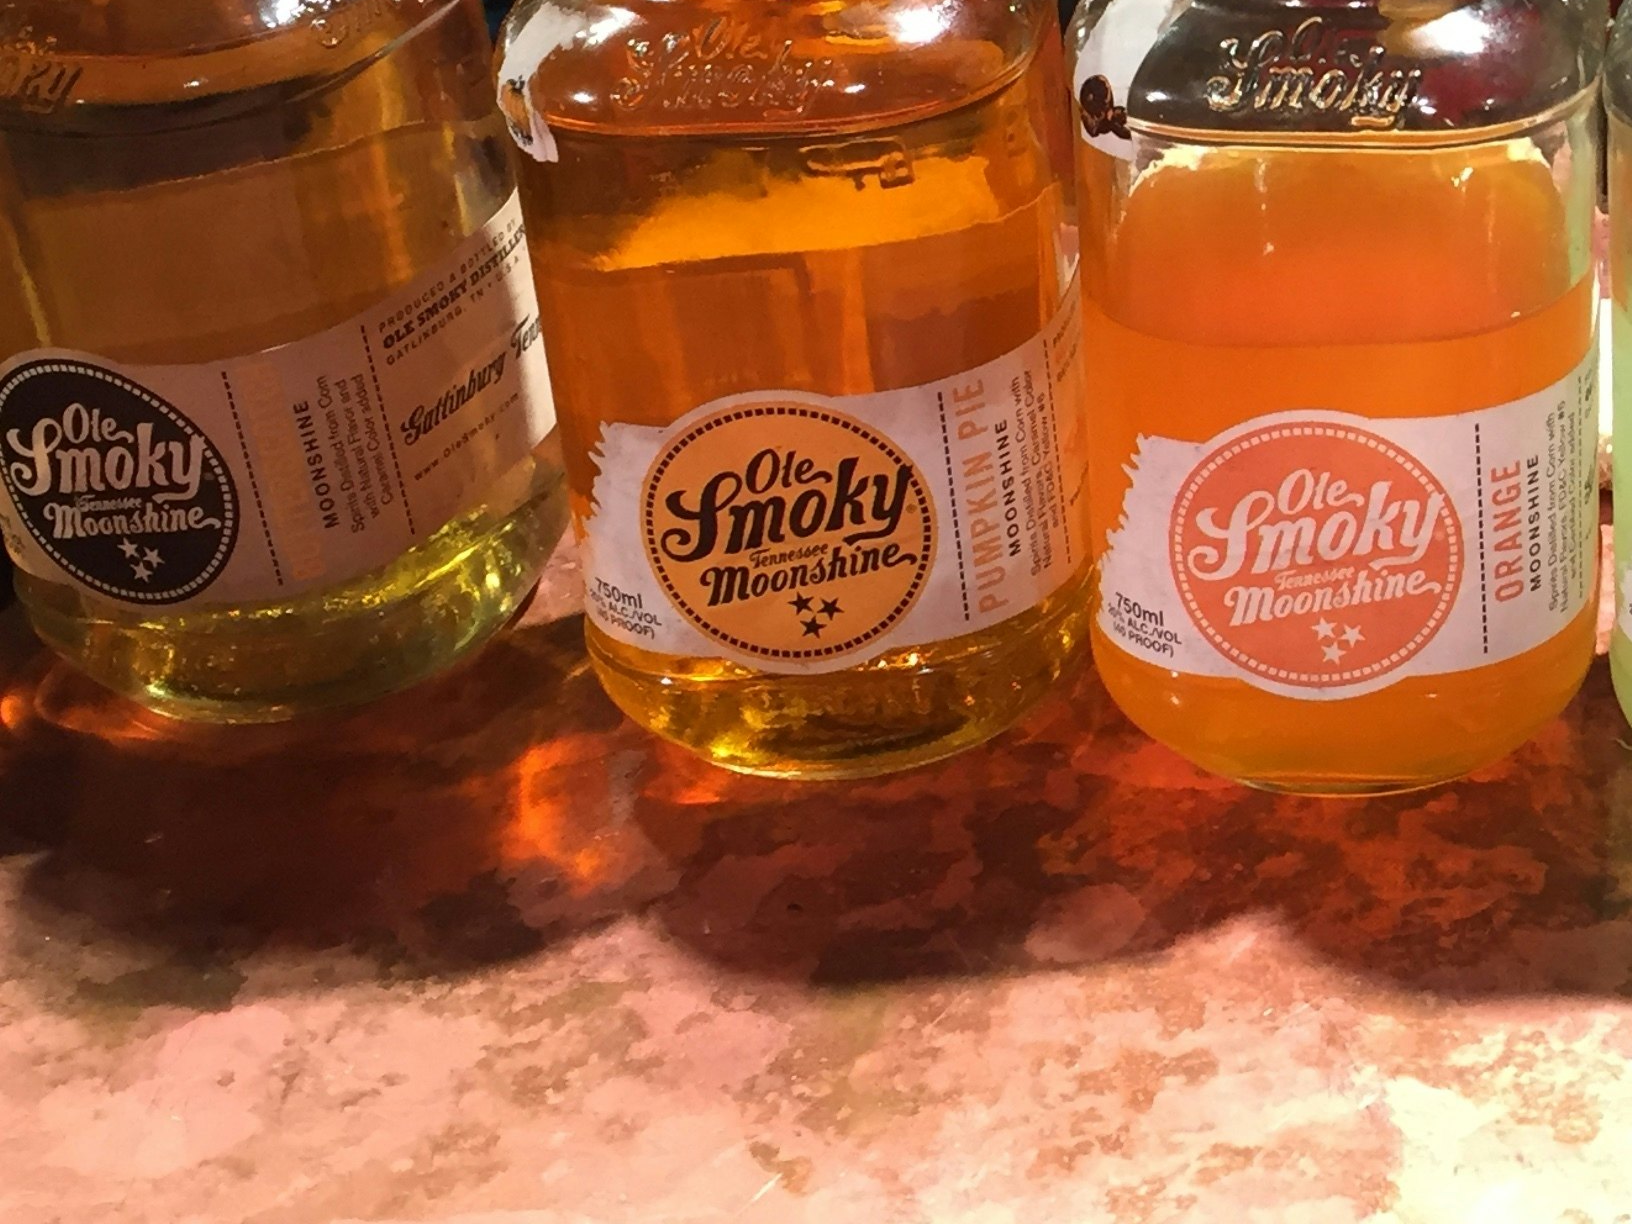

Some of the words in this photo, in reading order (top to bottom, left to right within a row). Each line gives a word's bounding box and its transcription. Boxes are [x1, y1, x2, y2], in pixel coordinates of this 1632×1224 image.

[1204, 30, 1424, 130] Smoky
[379, 281, 444, 333] PRODUCED
[383, 320, 416, 350] OLE
[416, 280, 468, 327] SMOKY
[316, 376, 333, 409] Corn
[333, 378, 350, 405] and
[350, 373, 372, 415] added
[952, 378, 989, 442] PIE
[1010, 376, 1022, 407] with
[62, 402, 134, 444] Ole
[325, 409, 340, 440] from
[364, 415, 380, 452] Color
[1014, 409, 1027, 444] Corn
[1026, 411, 1041, 466] Caramel
[1545, 411, 1555, 442] with
[6, 418, 206, 504] Smoky
[293, 400, 341, 529] MOONSHINE
[351, 445, 372, 492] Natural
[372, 451, 394, 506] Caramel
[745, 448, 833, 494] Ole
[1019, 444, 1031, 477] from
[1546, 443, 1556, 478] Corn
[362, 491, 380, 519] with
[660, 456, 915, 563] Smoky
[995, 419, 1022, 558] MOONSHINE
[1277, 468, 1365, 516] Ole
[1547, 479, 1556, 512] from
[43, 502, 222, 539] Moonshine
[961, 450, 1010, 615] PUMPKIN
[1187, 480, 1446, 581] Smoky
[1490, 459, 1525, 604] ORANGE
[1526, 454, 1542, 593] MOONSHINE
[700, 541, 918, 607] Moonshine
[750, 543, 828, 569] Tennessee
[595, 576, 643, 609] 750ml
[1223, 567, 1443, 628] Moonshine
[1273, 565, 1355, 592] Tennessee
[610, 614, 655, 640] PROOF)
[1115, 591, 1165, 627] 750ml
[1128, 630, 1175, 659] PROOF)
